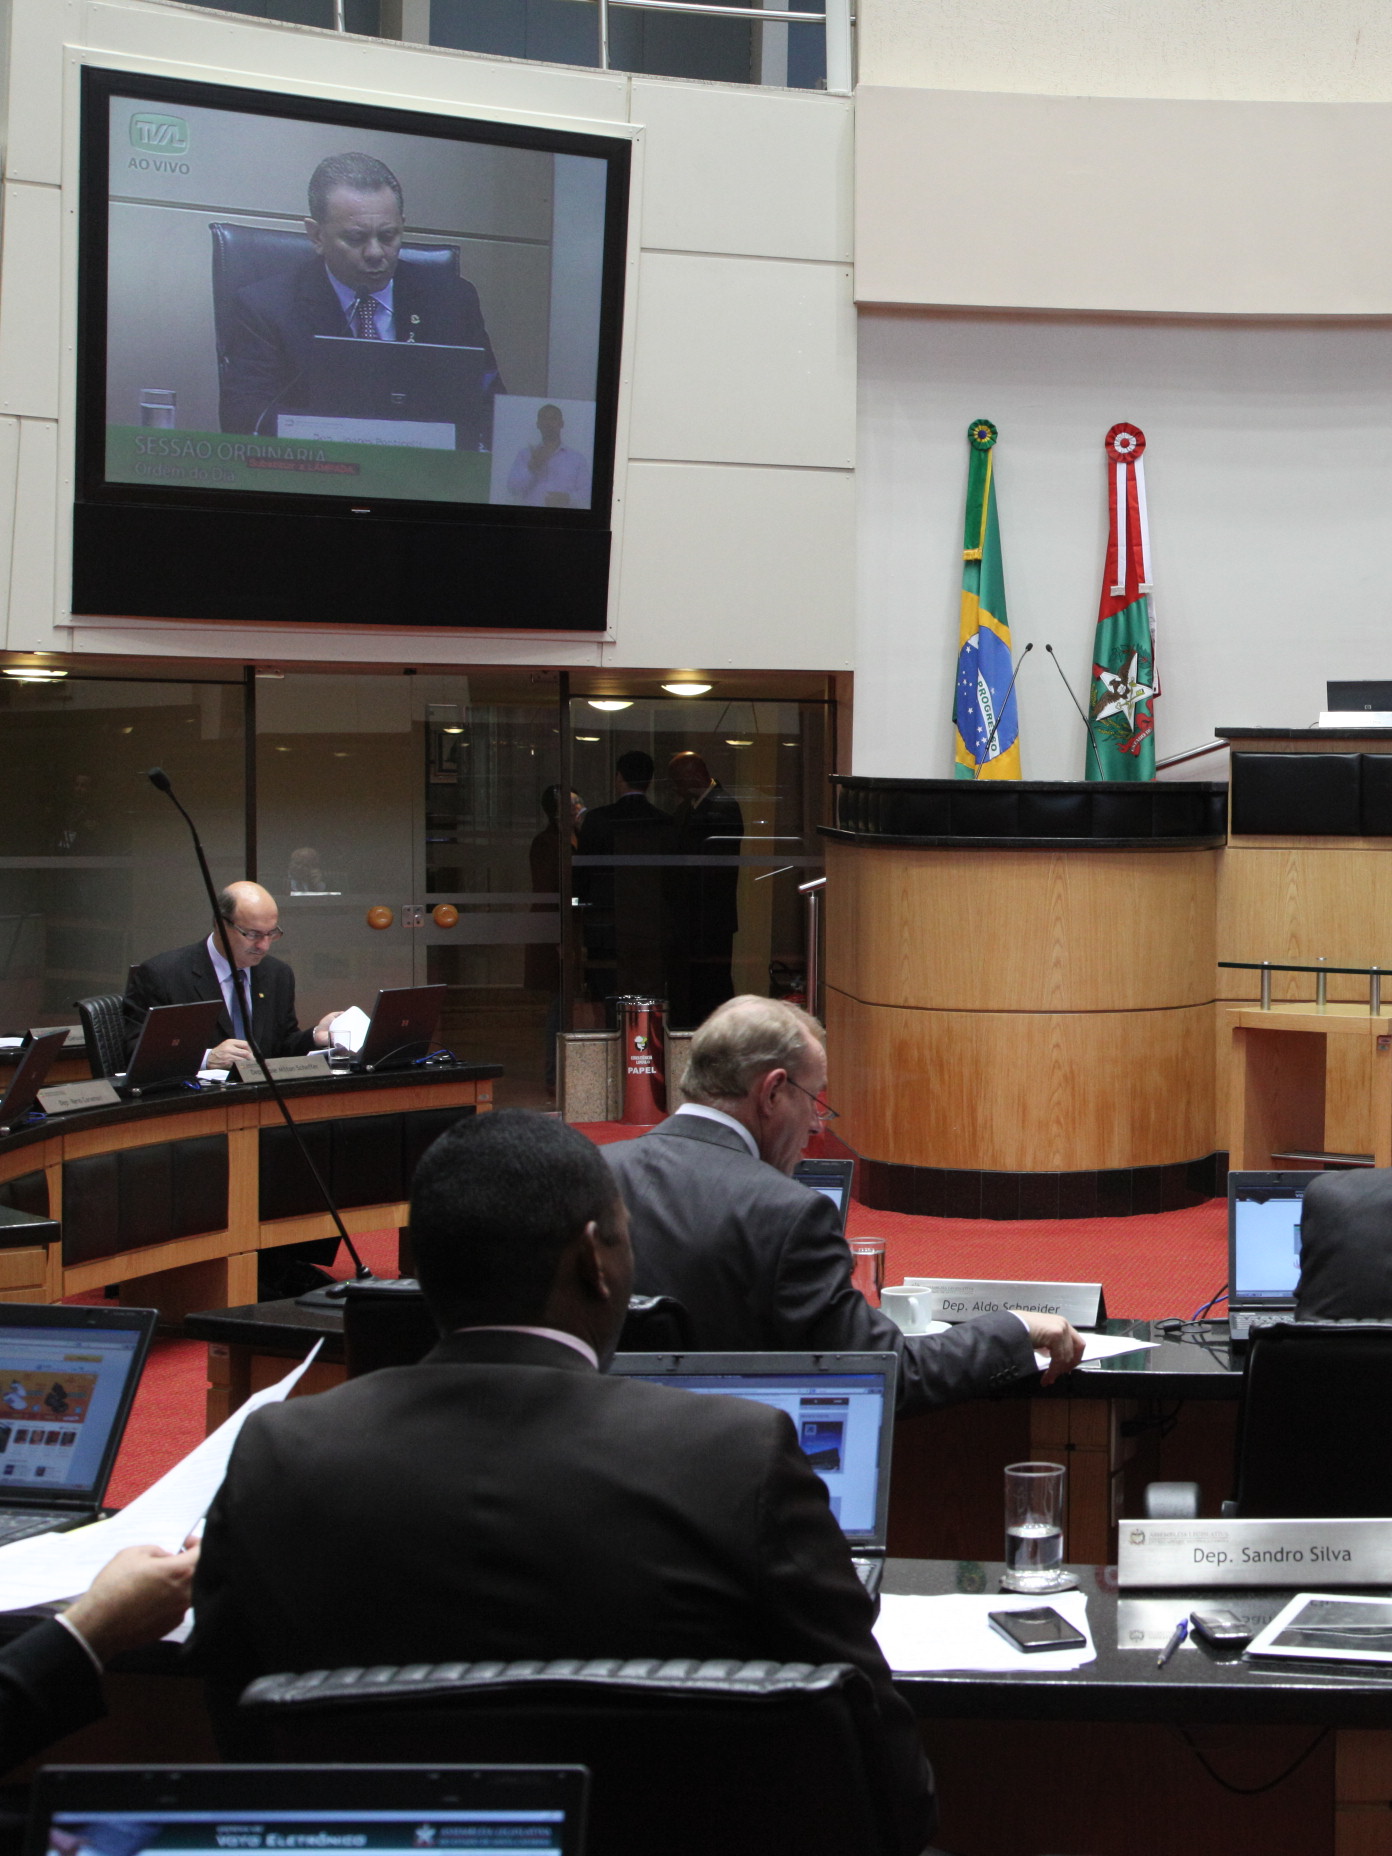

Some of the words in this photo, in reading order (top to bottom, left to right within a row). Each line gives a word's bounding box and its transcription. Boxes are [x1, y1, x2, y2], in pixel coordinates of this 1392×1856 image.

[128, 157, 150, 170] AO
[152, 160, 190, 175] VIVO
[190, 467, 208, 479] do
[978, 681, 997, 751] PROGRESO
[627, 1066, 657, 1074] PAPEL
[942, 1300, 968, 1313] Dep.
[972, 1301, 999, 1312] Aldo
[1193, 1548, 1234, 1566] Dep.
[1241, 1547, 1304, 1563] Sandro
[1310, 1546, 1352, 1562] Silva
[216, 1834, 262, 1847] VOTO
